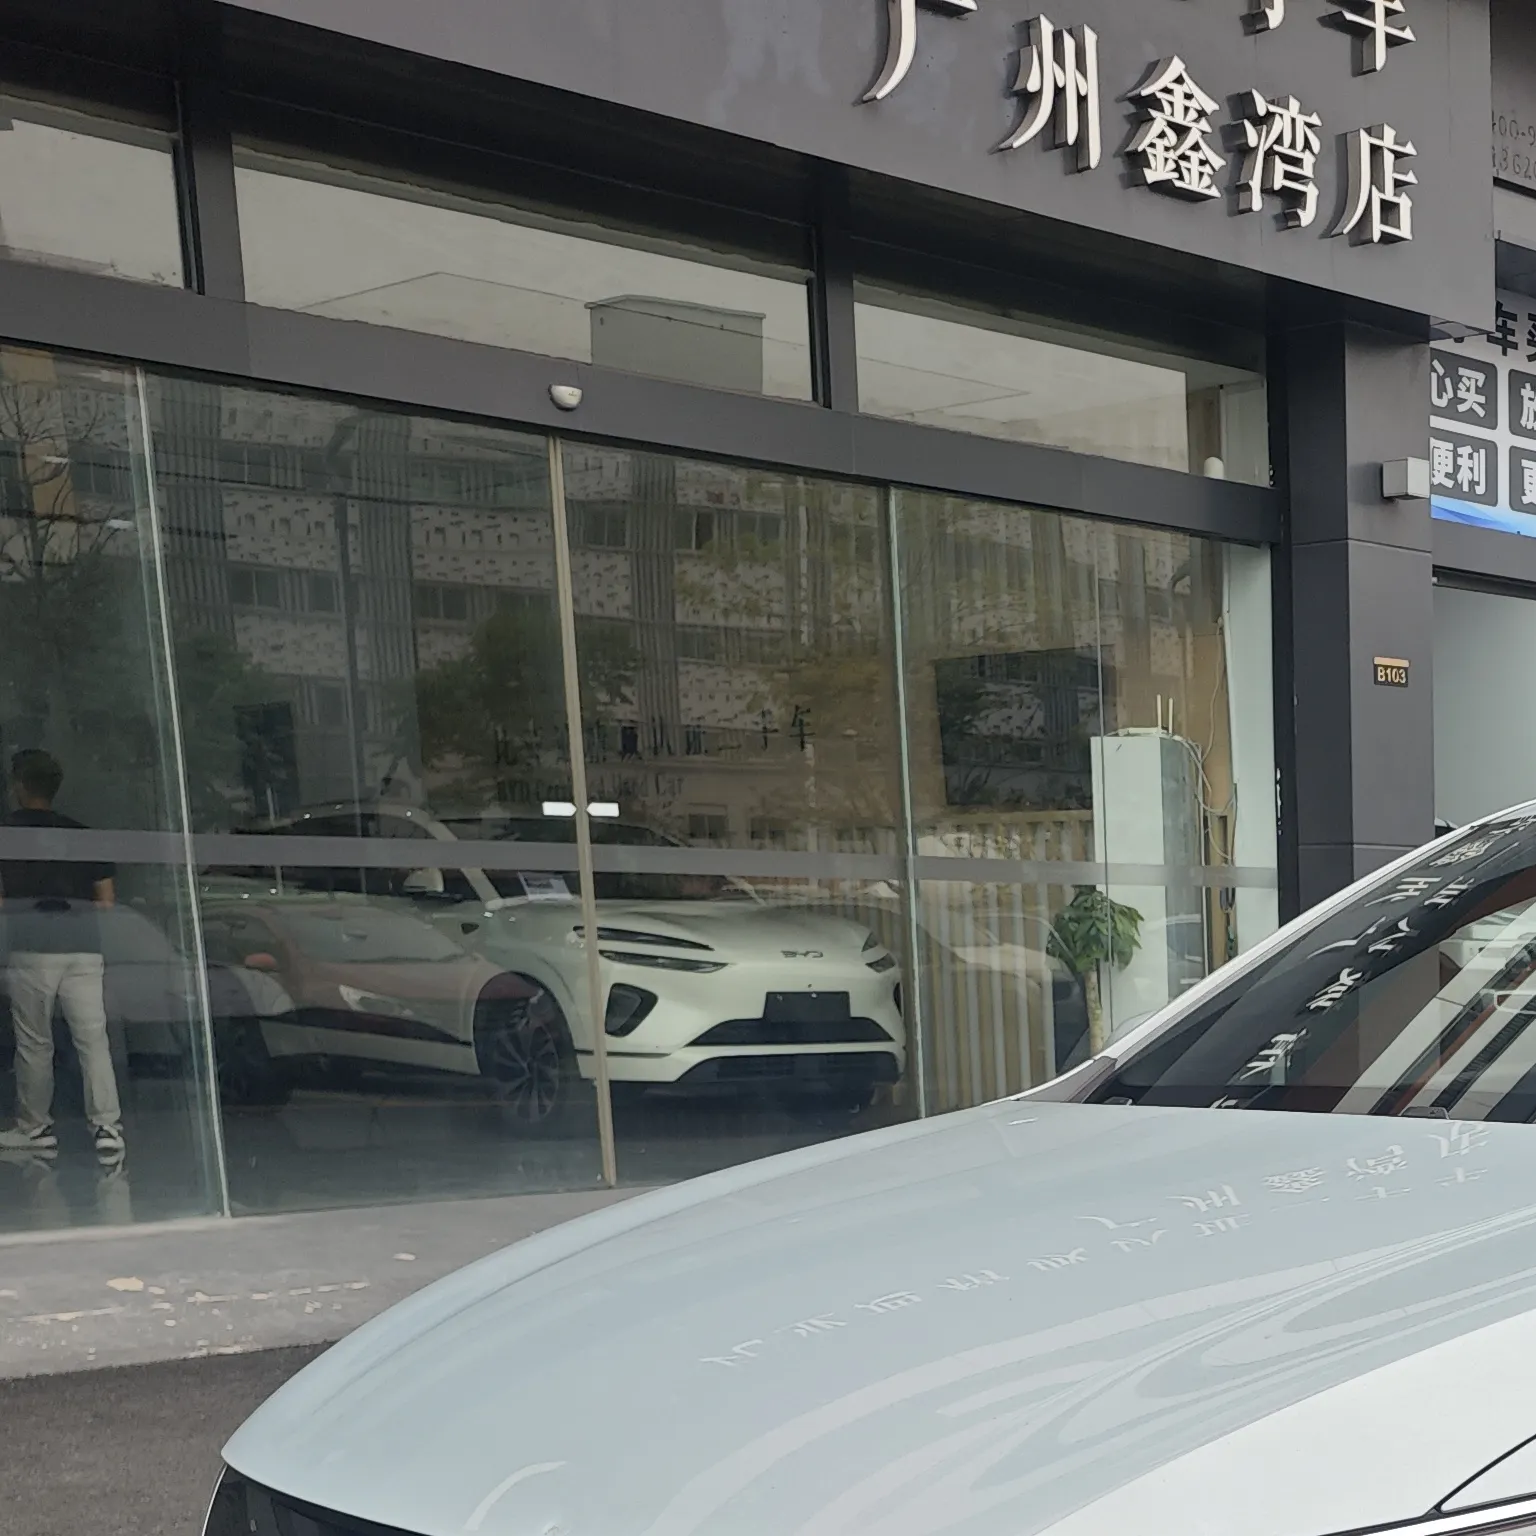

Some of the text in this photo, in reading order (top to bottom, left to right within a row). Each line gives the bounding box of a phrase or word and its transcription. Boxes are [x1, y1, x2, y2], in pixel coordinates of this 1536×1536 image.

[858, 0, 1417, 243] 广州鑫湾店
[1430, 358, 1486, 418] 心买
[1377, 666, 1406, 684] B103
